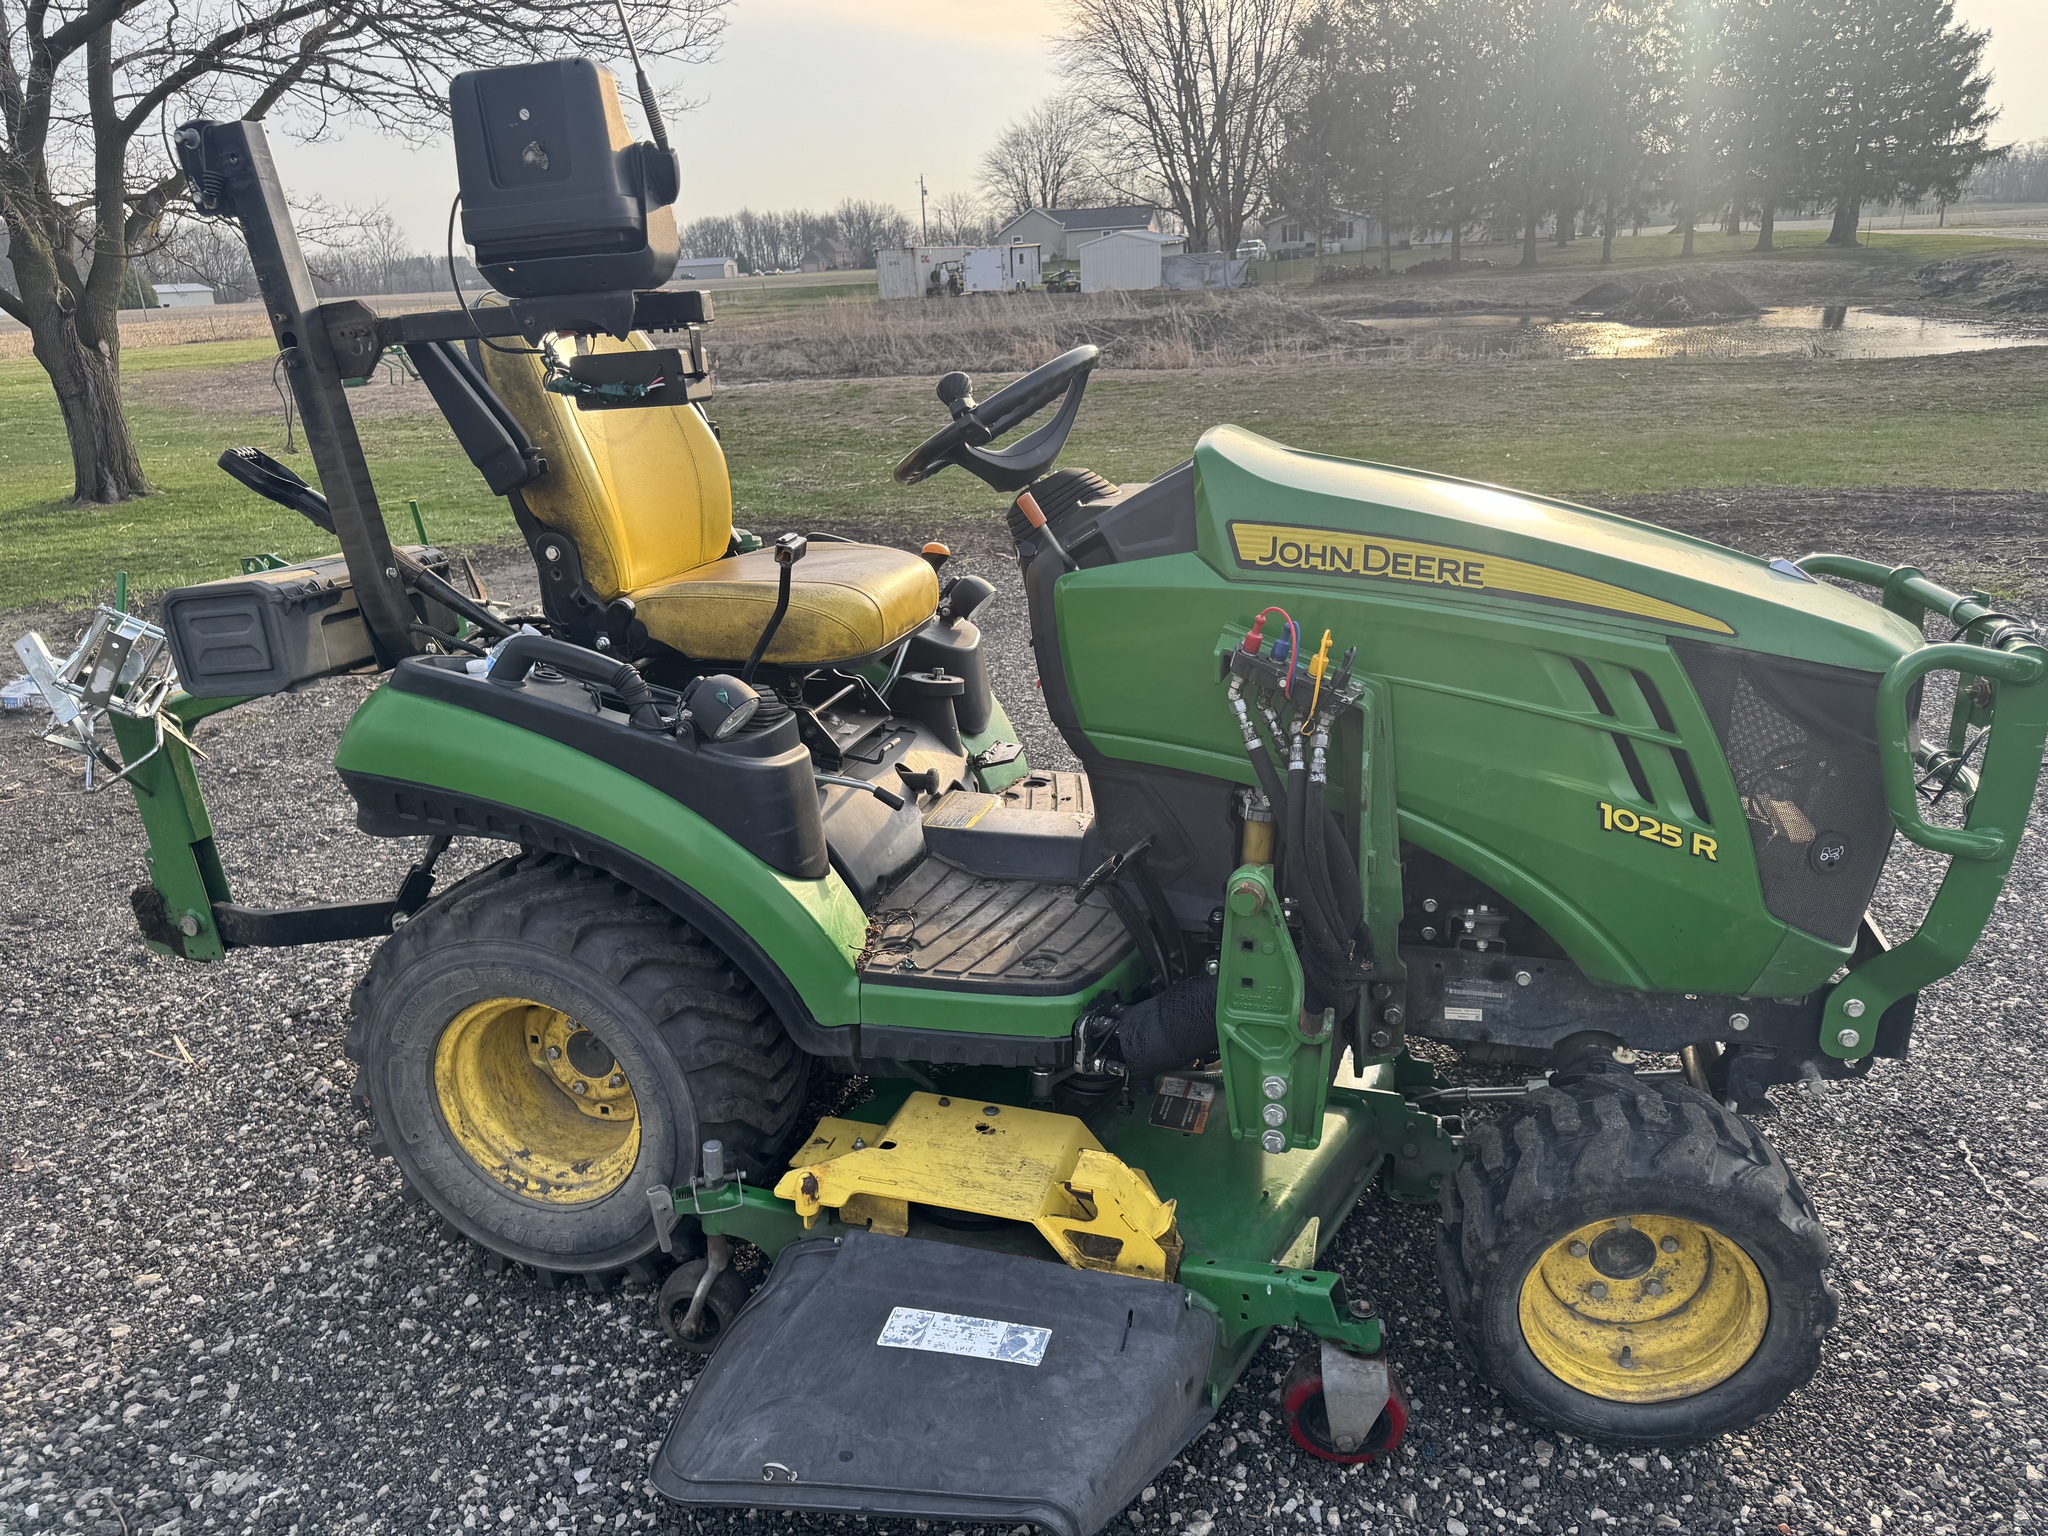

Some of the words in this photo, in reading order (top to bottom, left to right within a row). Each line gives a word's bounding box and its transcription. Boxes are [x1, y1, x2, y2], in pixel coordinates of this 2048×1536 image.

[1258, 536, 1353, 571] JOHN
[1361, 543, 1485, 588] DEERE
[1597, 801, 1684, 848] 1025
[1690, 831, 1719, 862] R
[477, 968, 555, 993] TRAC
